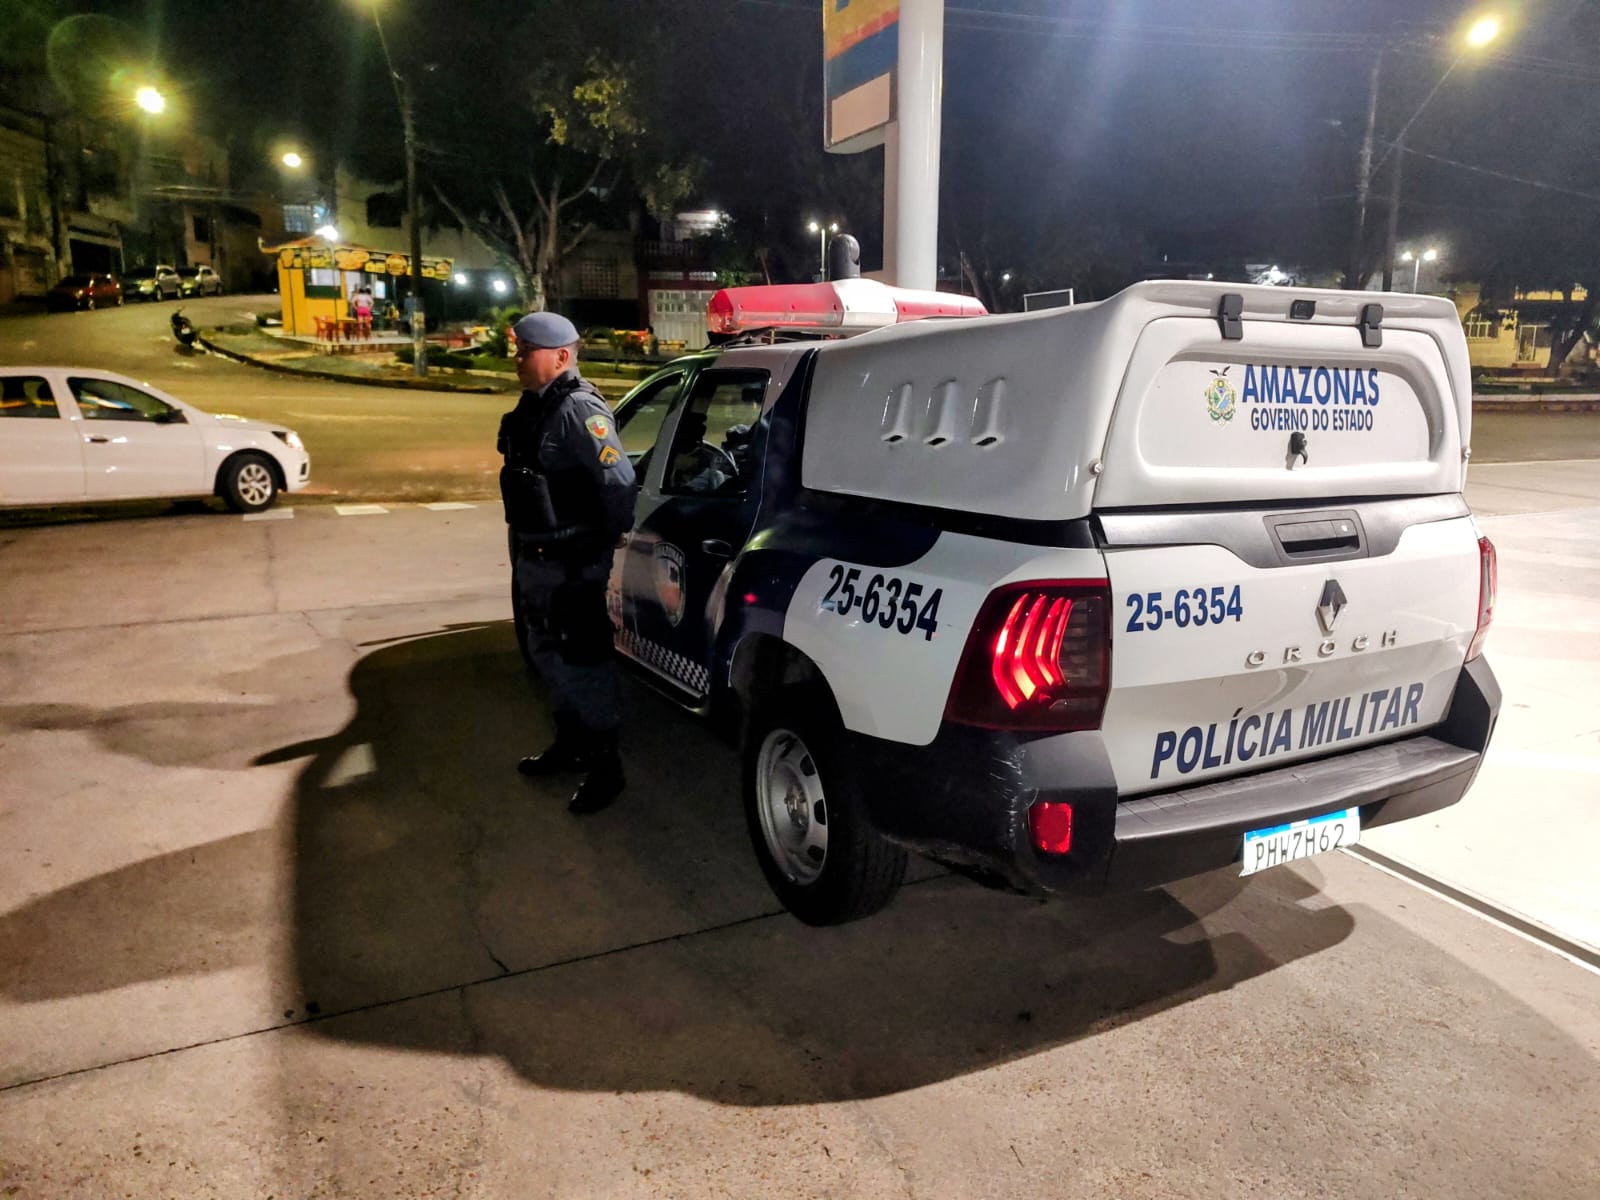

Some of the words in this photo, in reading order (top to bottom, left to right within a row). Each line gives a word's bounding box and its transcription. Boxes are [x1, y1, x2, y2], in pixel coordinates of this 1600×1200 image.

[1242, 364, 1380, 406] AMAZONAS
[1251, 407, 1308, 431] GOVERNO
[1312, 409, 1329, 431] DO
[1333, 409, 1373, 431] ESTADO
[821, 564, 943, 641] 25-6354
[1126, 584, 1243, 632] 25-6354
[1244, 630, 1396, 669] OROCH
[1150, 707, 1292, 779] POLÍCIA
[1299, 682, 1424, 749] MILITAR
[1255, 823, 1344, 870] PHW7H62
